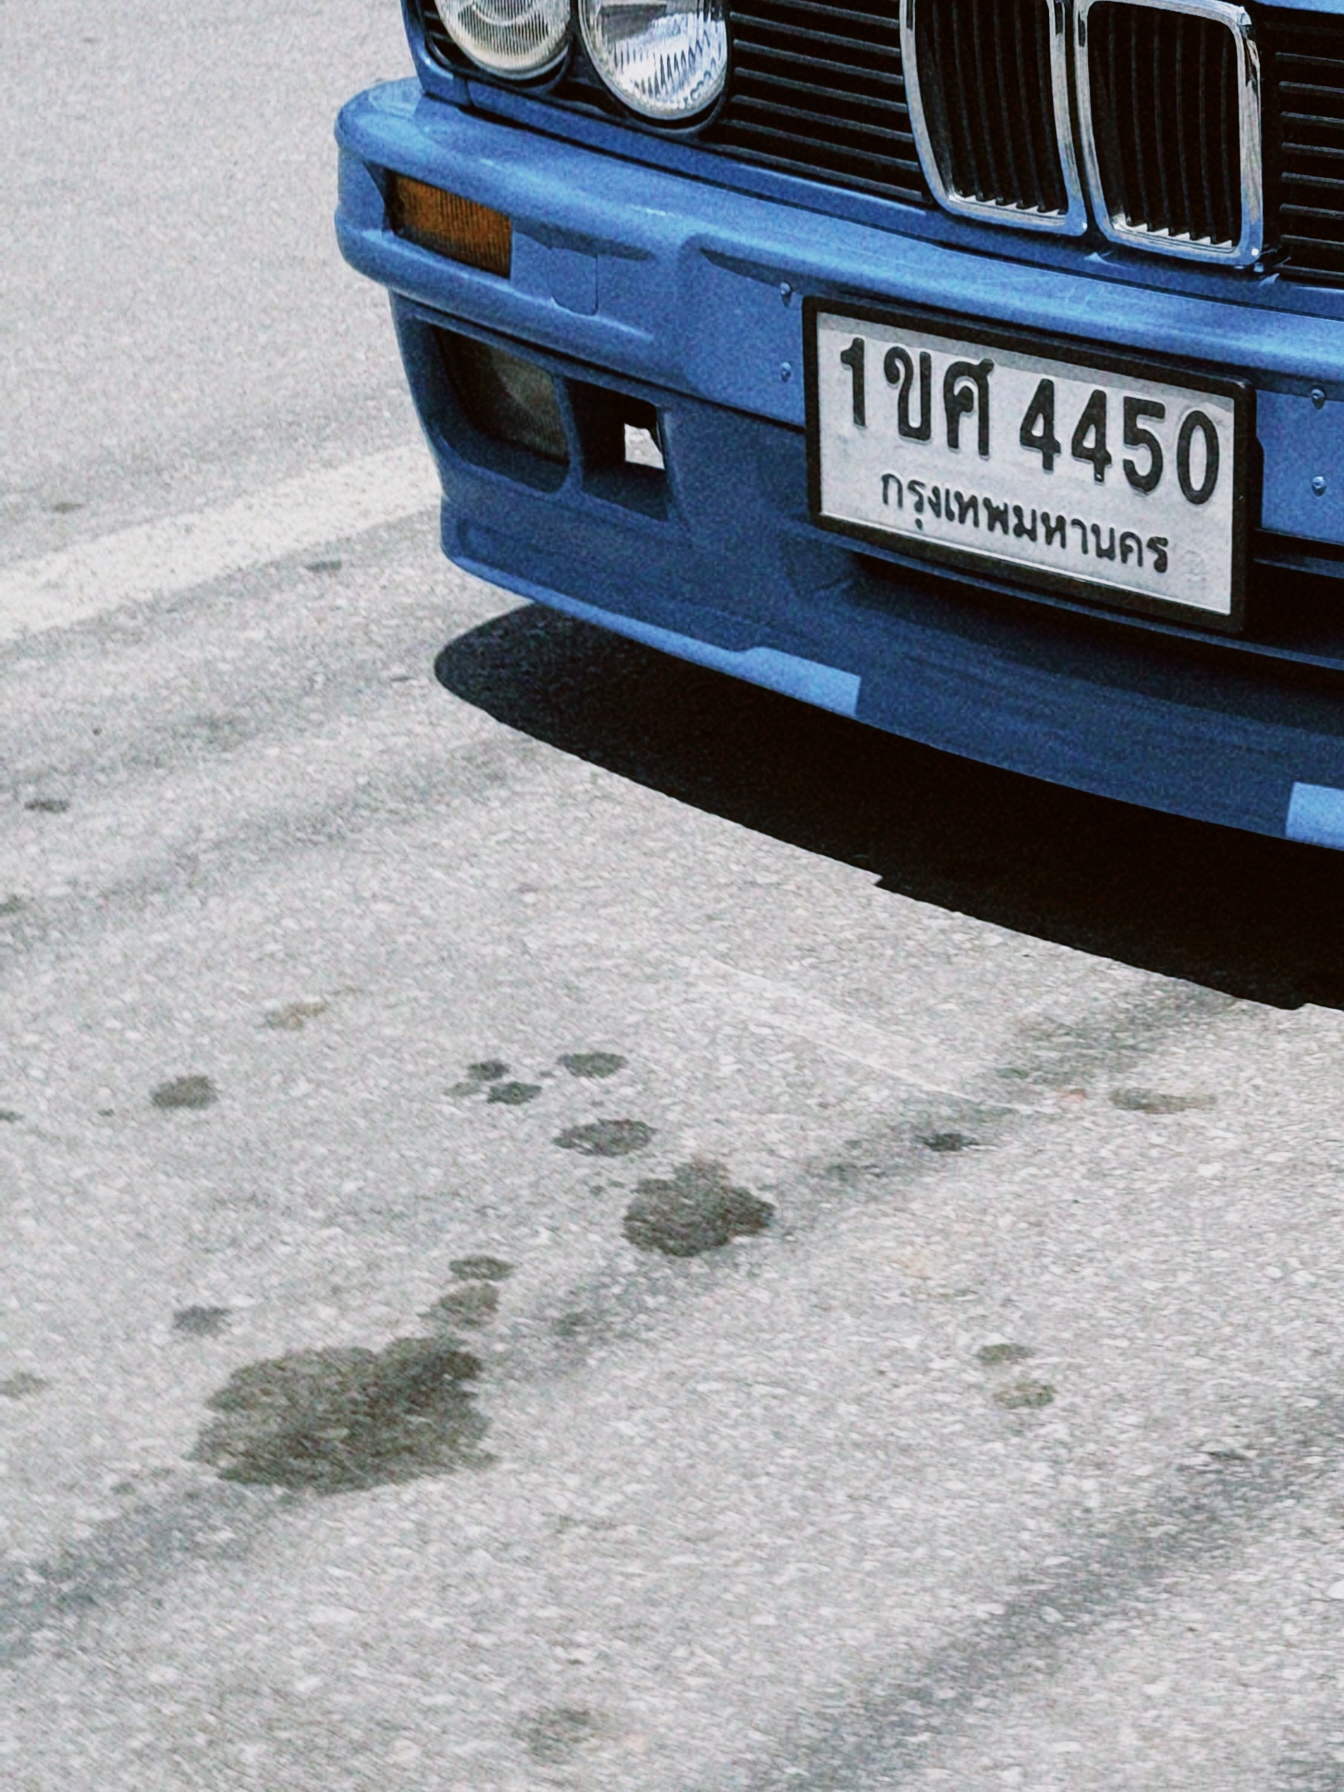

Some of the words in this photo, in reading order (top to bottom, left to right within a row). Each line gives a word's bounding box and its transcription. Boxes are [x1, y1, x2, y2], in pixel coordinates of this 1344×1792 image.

[839, 336, 995, 460] 1ขศ
[1019, 377, 1221, 506] 4450
[880, 472, 1169, 574] กรุงเทพมหานคร
